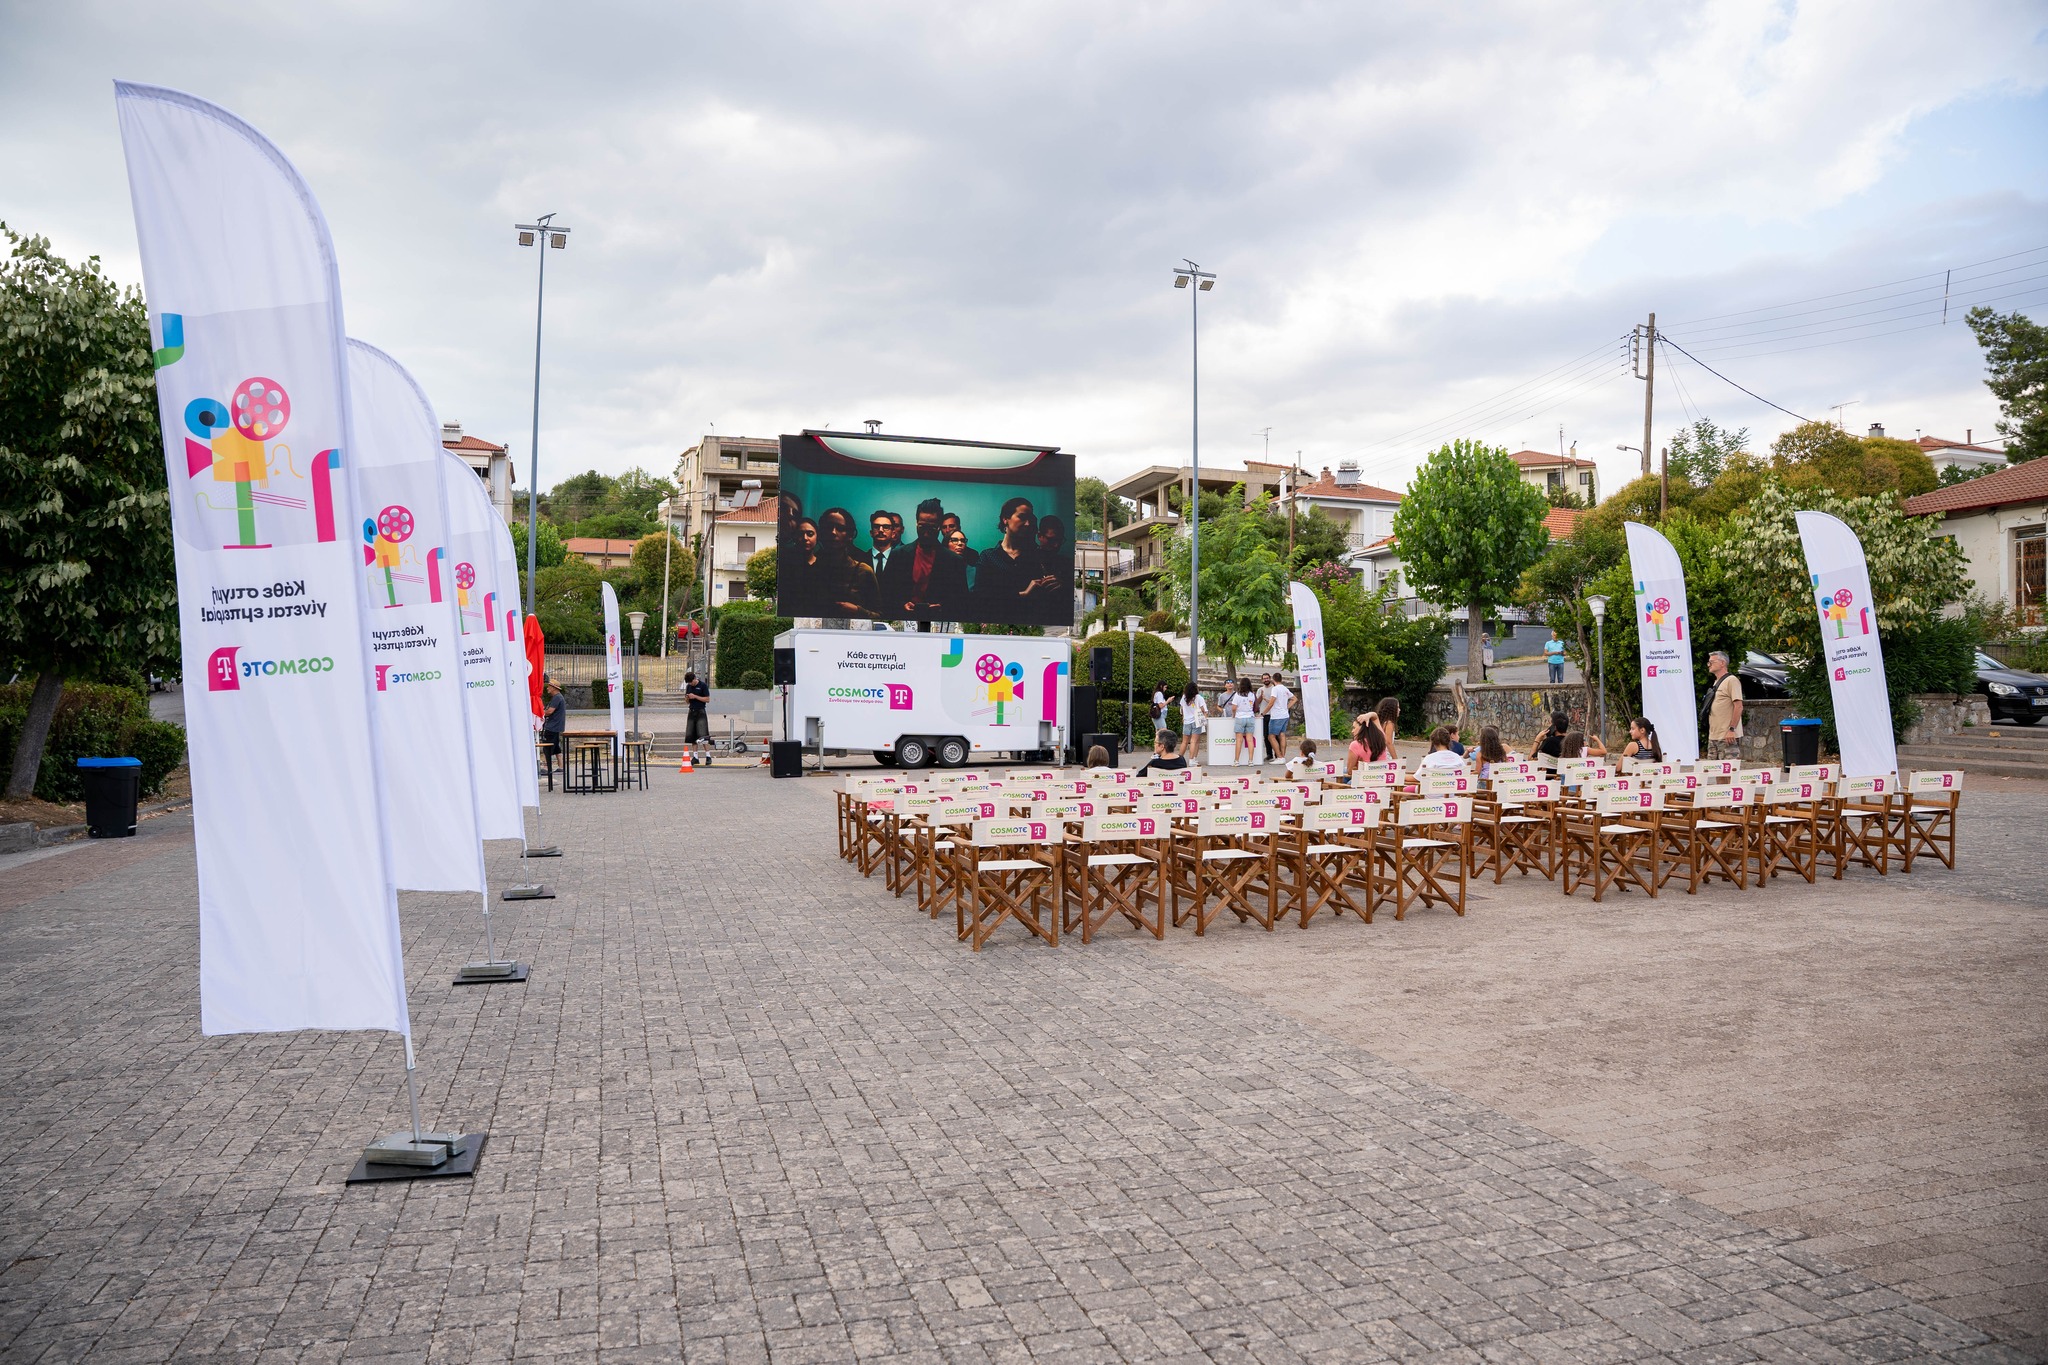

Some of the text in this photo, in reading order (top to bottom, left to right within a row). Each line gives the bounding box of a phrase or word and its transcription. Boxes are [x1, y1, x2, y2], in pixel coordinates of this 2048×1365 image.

[847, 651, 896, 662] Κάθε στιγμή
[838, 660, 906, 671] γίνεται εμπειρία!
[828, 688, 884, 698] COSMOTE
